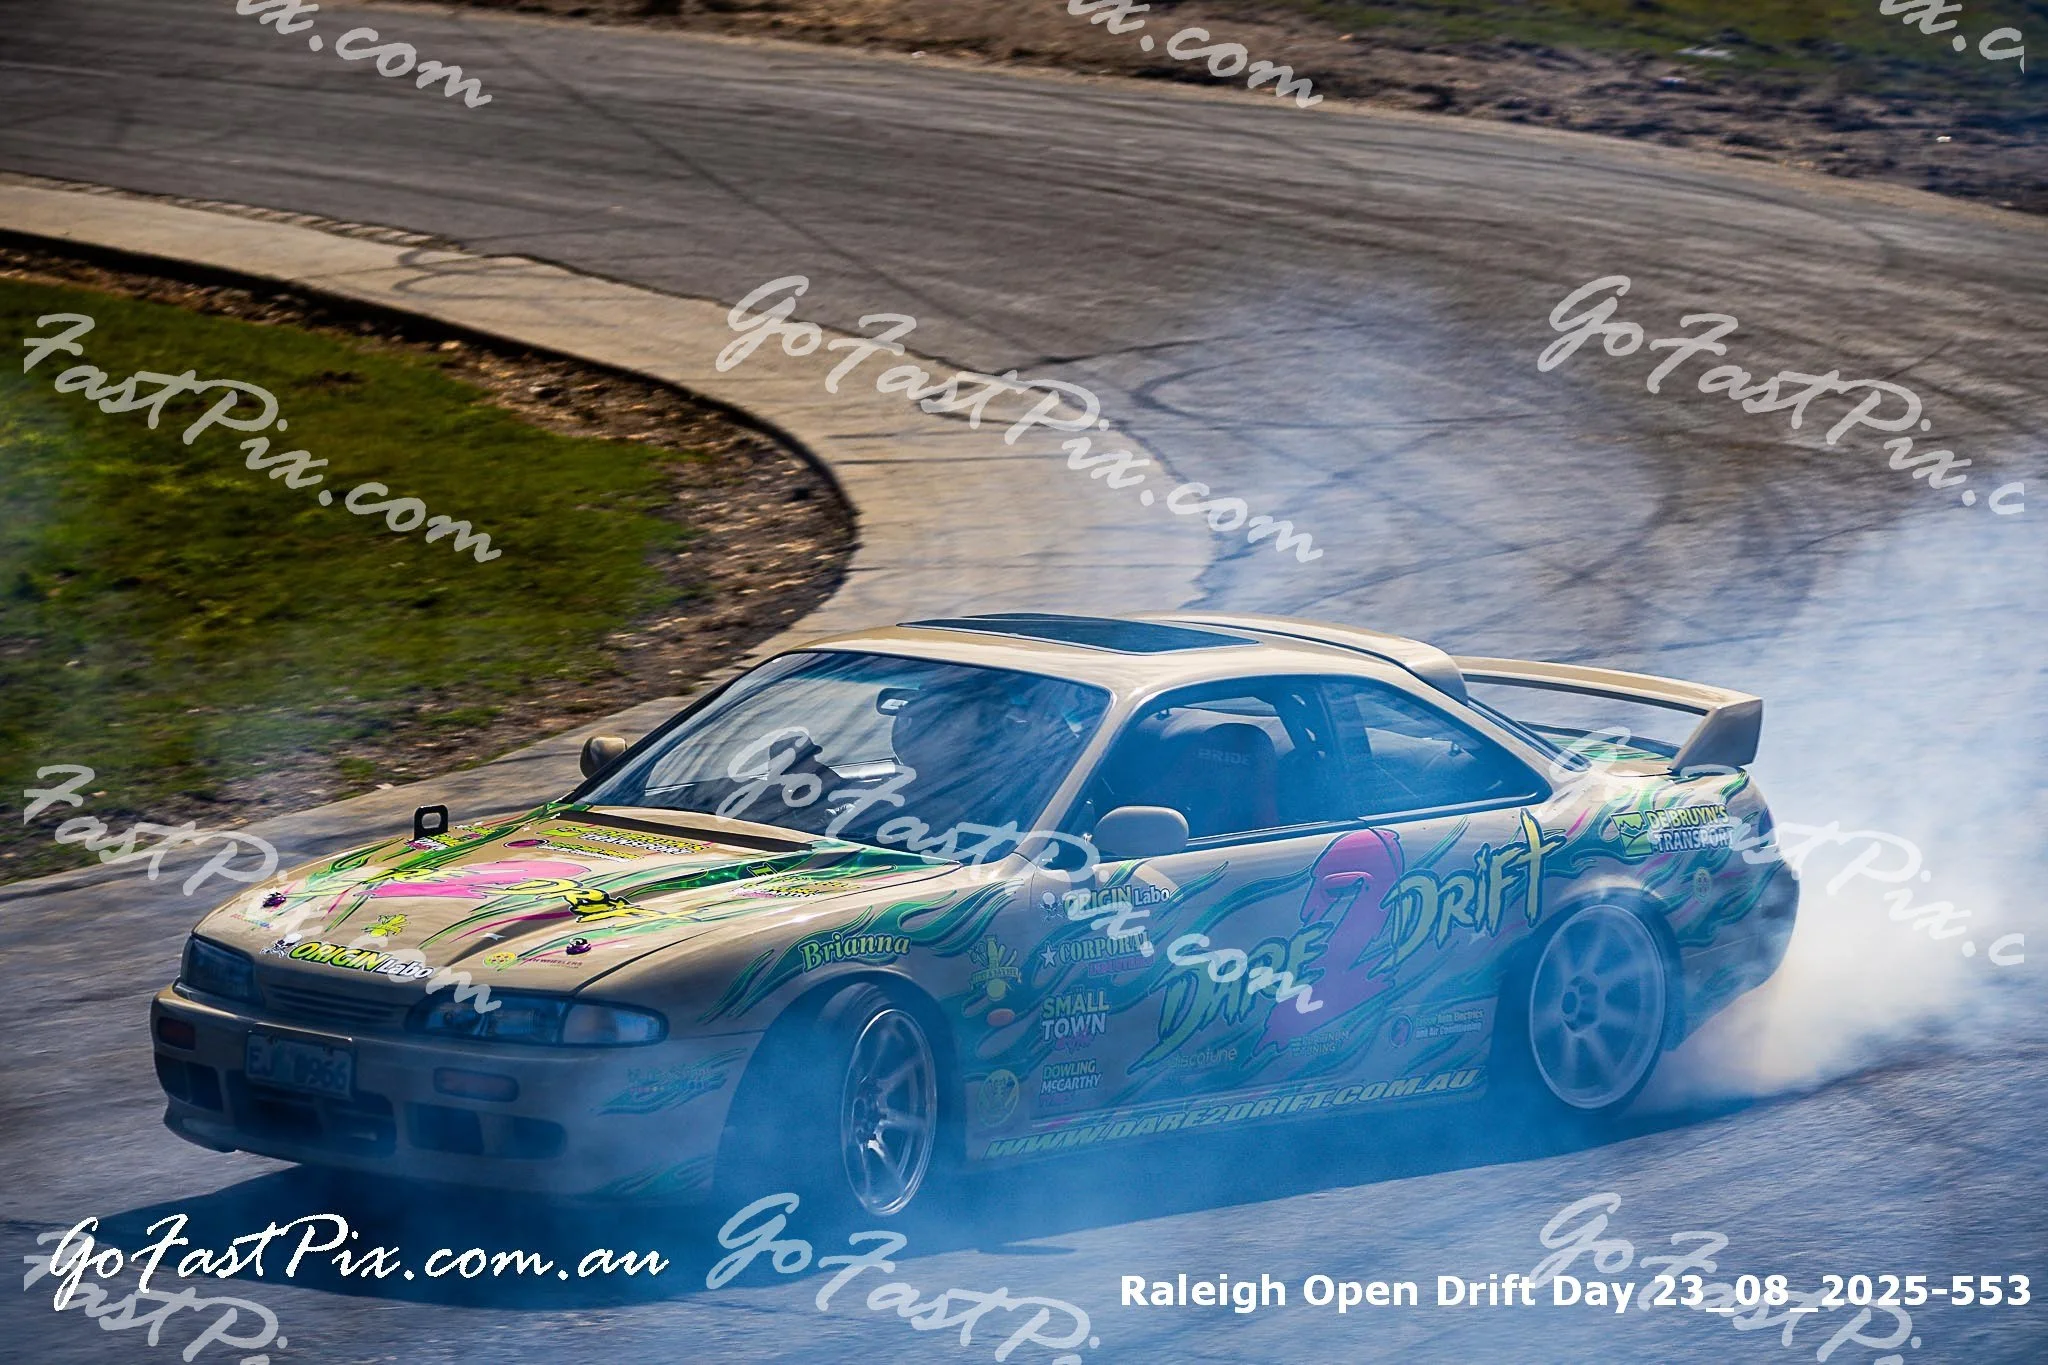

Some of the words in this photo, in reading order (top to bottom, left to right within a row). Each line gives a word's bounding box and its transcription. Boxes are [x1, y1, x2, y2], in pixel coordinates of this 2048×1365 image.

[1655, 826, 1735, 853] TRANSPORT
[1133, 884, 1171, 907] Labo
[288, 940, 388, 973] ORIGIN
[377, 957, 435, 979] Labo
[799, 932, 911, 973] Brianna
[1042, 988, 1111, 1020] SMALL
[1041, 1011, 1107, 1042] TOWN
[1043, 1059, 1098, 1080] DOWLING
[982, 1067, 1482, 1161] WWW.DARE2DRIFT.COM.AU
